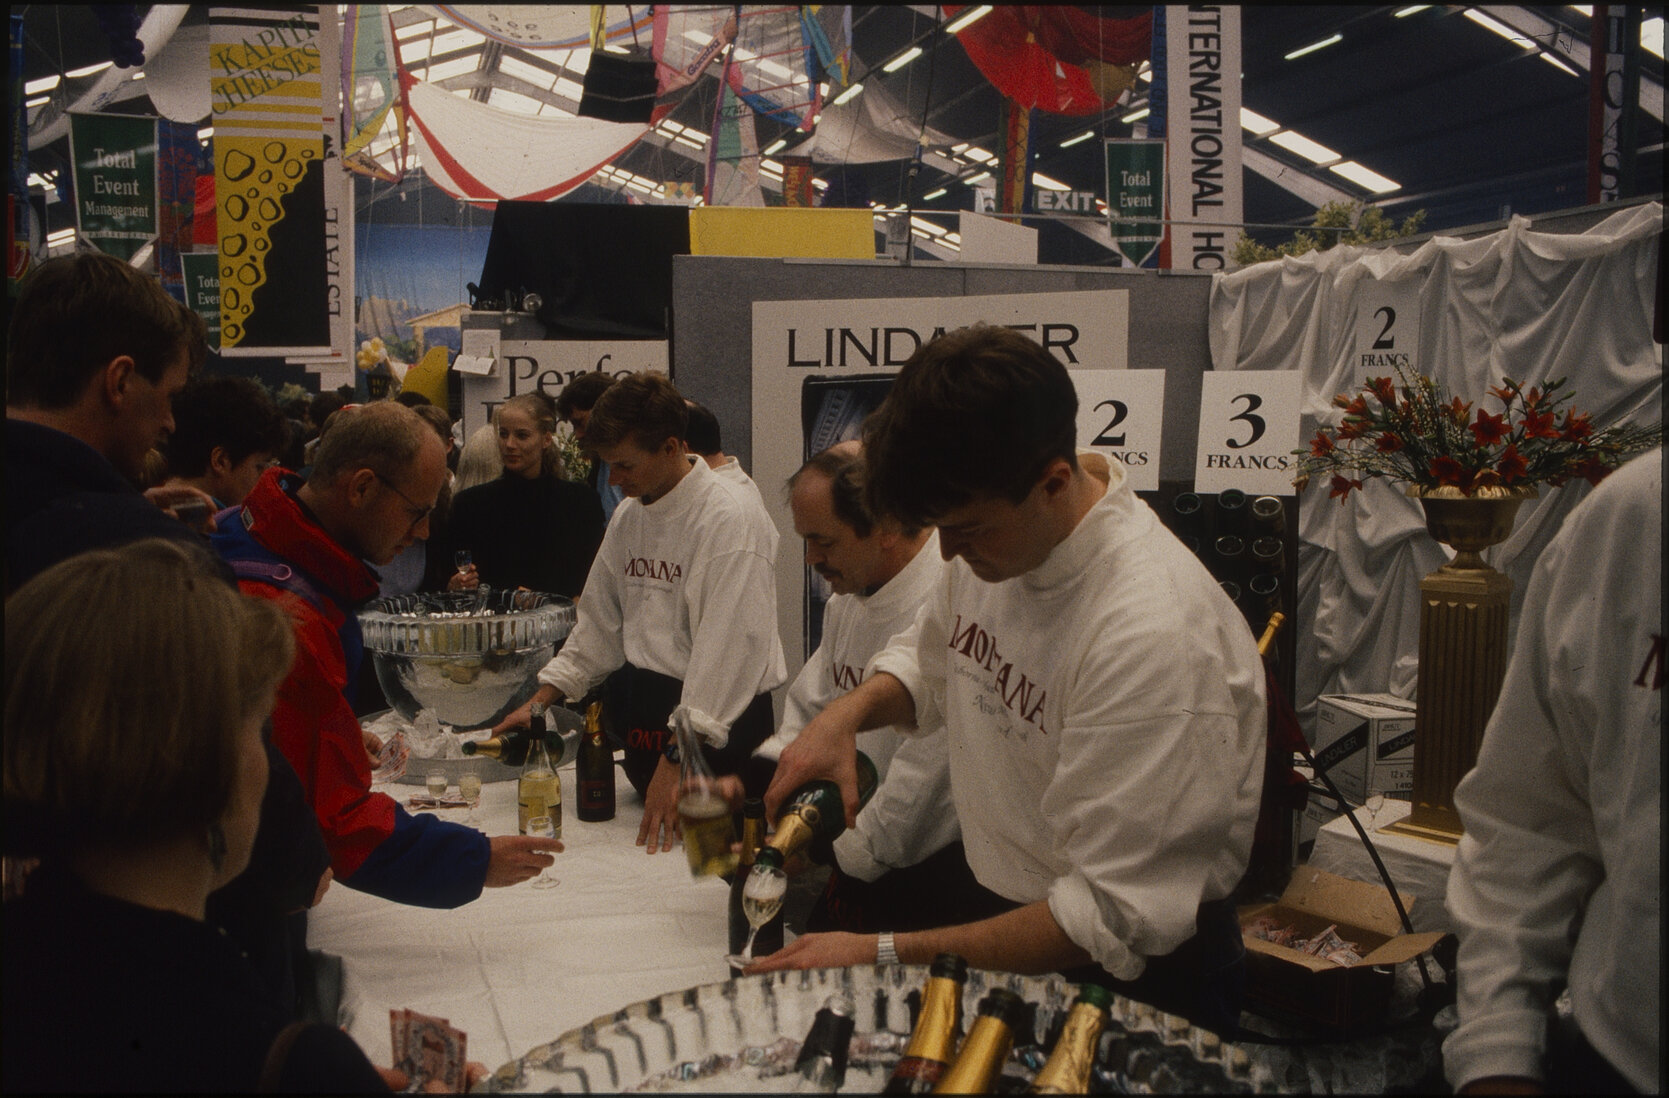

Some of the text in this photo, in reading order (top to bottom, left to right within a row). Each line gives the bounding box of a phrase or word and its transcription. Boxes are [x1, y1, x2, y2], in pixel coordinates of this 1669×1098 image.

[93, 148, 136, 169] Total
[93, 175, 140, 196] Event
[1121, 170, 1151, 187] Total
[84, 200, 150, 219] Management
[1038, 190, 1095, 212] EXIT
[1120, 192, 1153, 208] Event
[197, 274, 220, 289] Tota
[1372, 306, 1396, 349] 2
[787, 323, 1080, 368] LINDR
[1361, 353, 1409, 368] FRANCS
[1090, 400, 1128, 446] 2
[1226, 393, 1266, 449] 3
[1111, 452, 1149, 466] NCS
[1206, 454, 1289, 471] FRANCS
